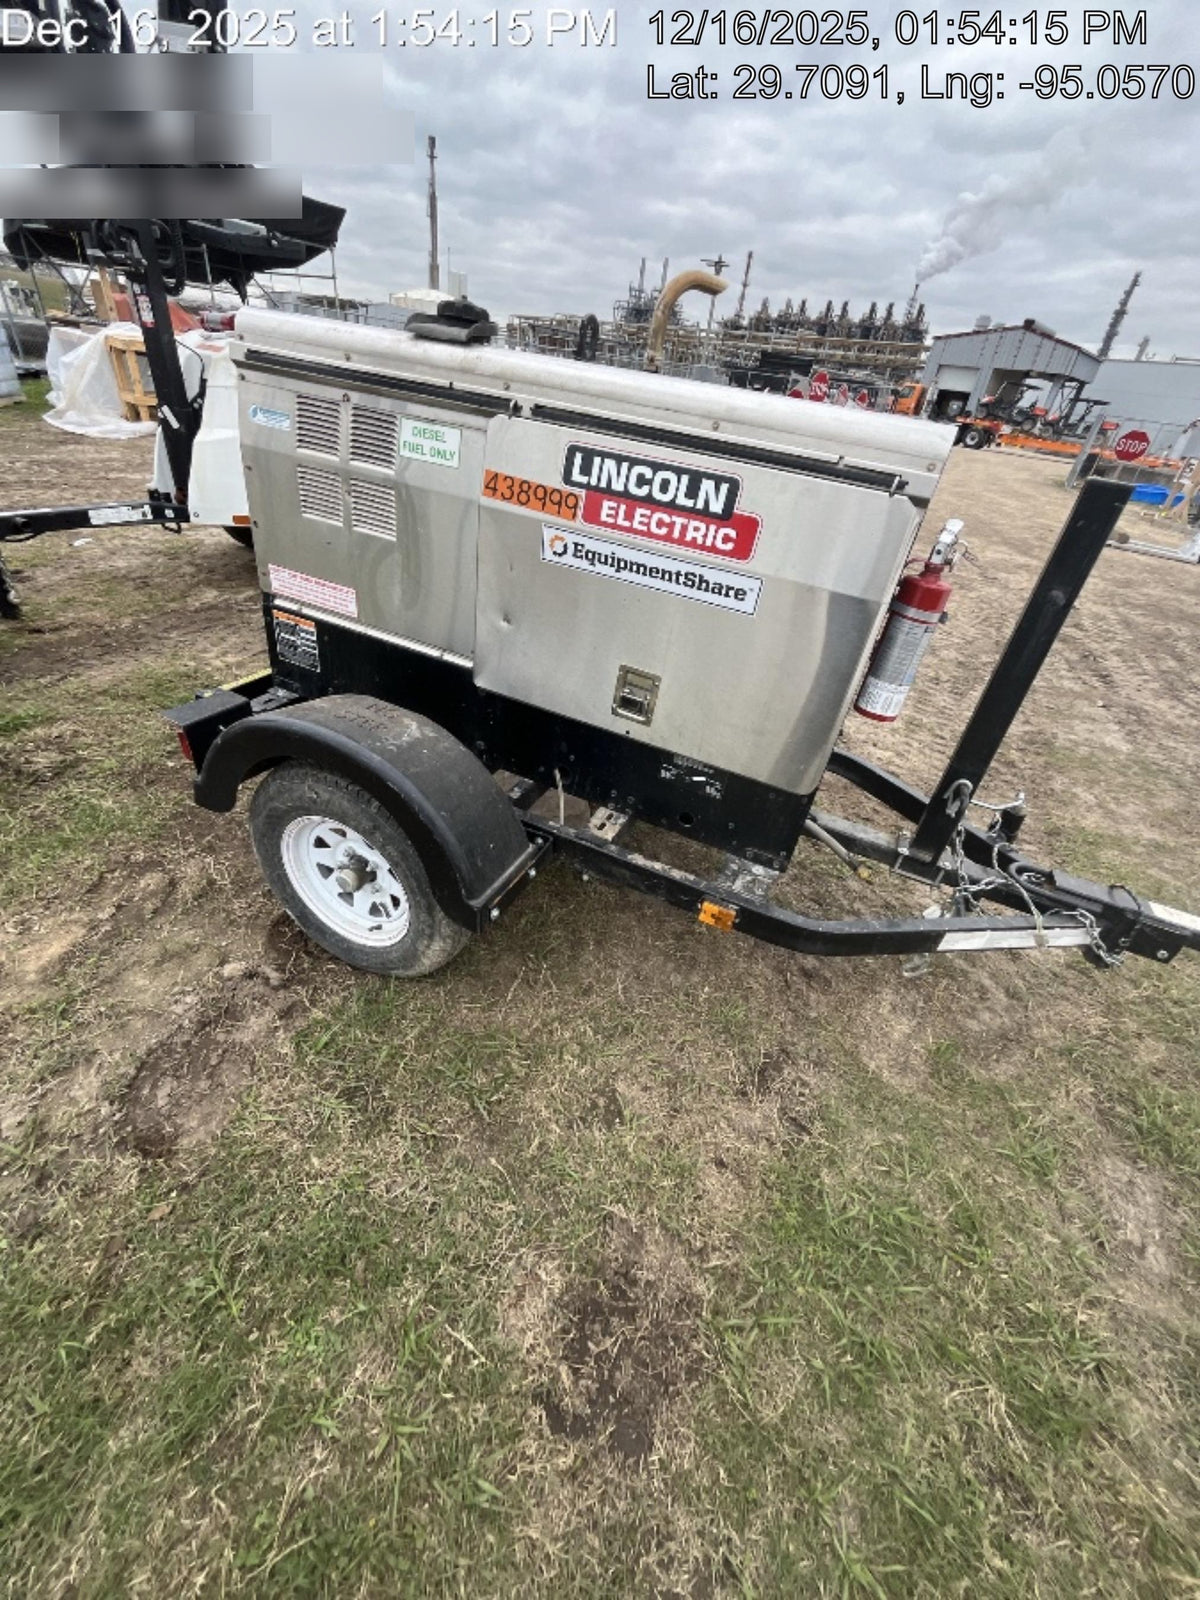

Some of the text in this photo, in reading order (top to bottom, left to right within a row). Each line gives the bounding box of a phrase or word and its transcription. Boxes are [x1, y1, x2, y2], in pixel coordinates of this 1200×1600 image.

[402, 440, 456, 461] FUEL ONLY
[411, 425, 447, 443] DIESEL
[1116, 438, 1148, 454] STOP
[484, 472, 579, 520] 438999
[571, 451, 730, 515] LINCOLN
[600, 499, 737, 551] ELECTRIC
[572, 541, 748, 602] EquipmentShare
